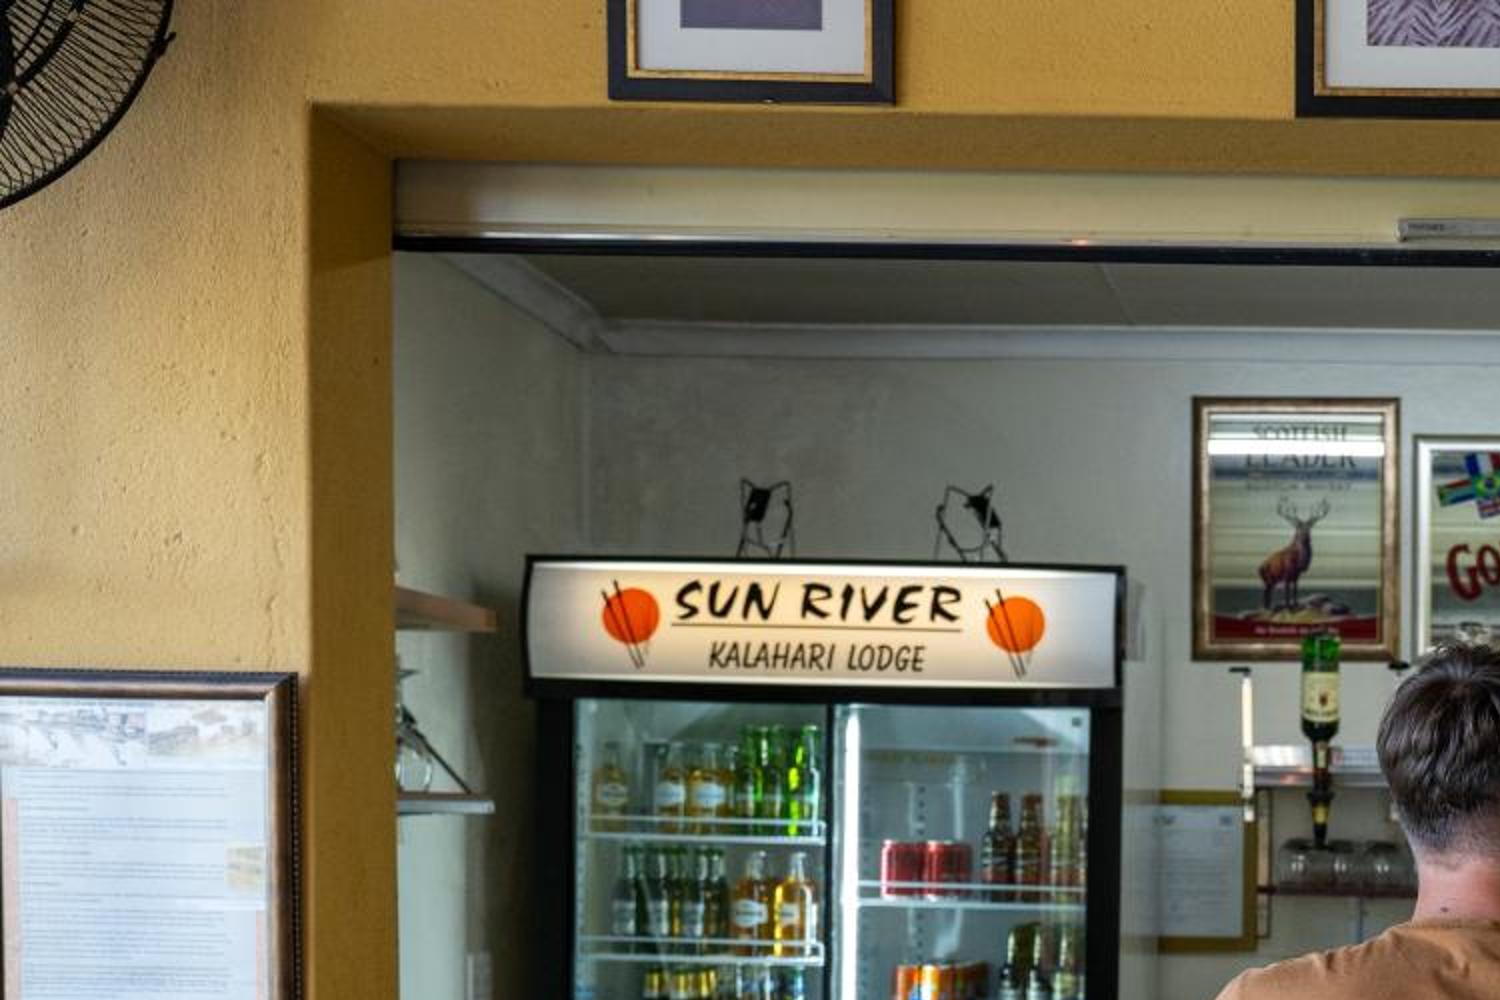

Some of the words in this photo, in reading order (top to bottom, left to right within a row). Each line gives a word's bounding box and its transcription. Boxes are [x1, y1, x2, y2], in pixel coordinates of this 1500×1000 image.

[675, 580, 781, 620] SUN
[801, 582, 962, 624] RIVER
[708, 641, 834, 669] KALAHARI
[847, 644, 926, 672] LODGE
